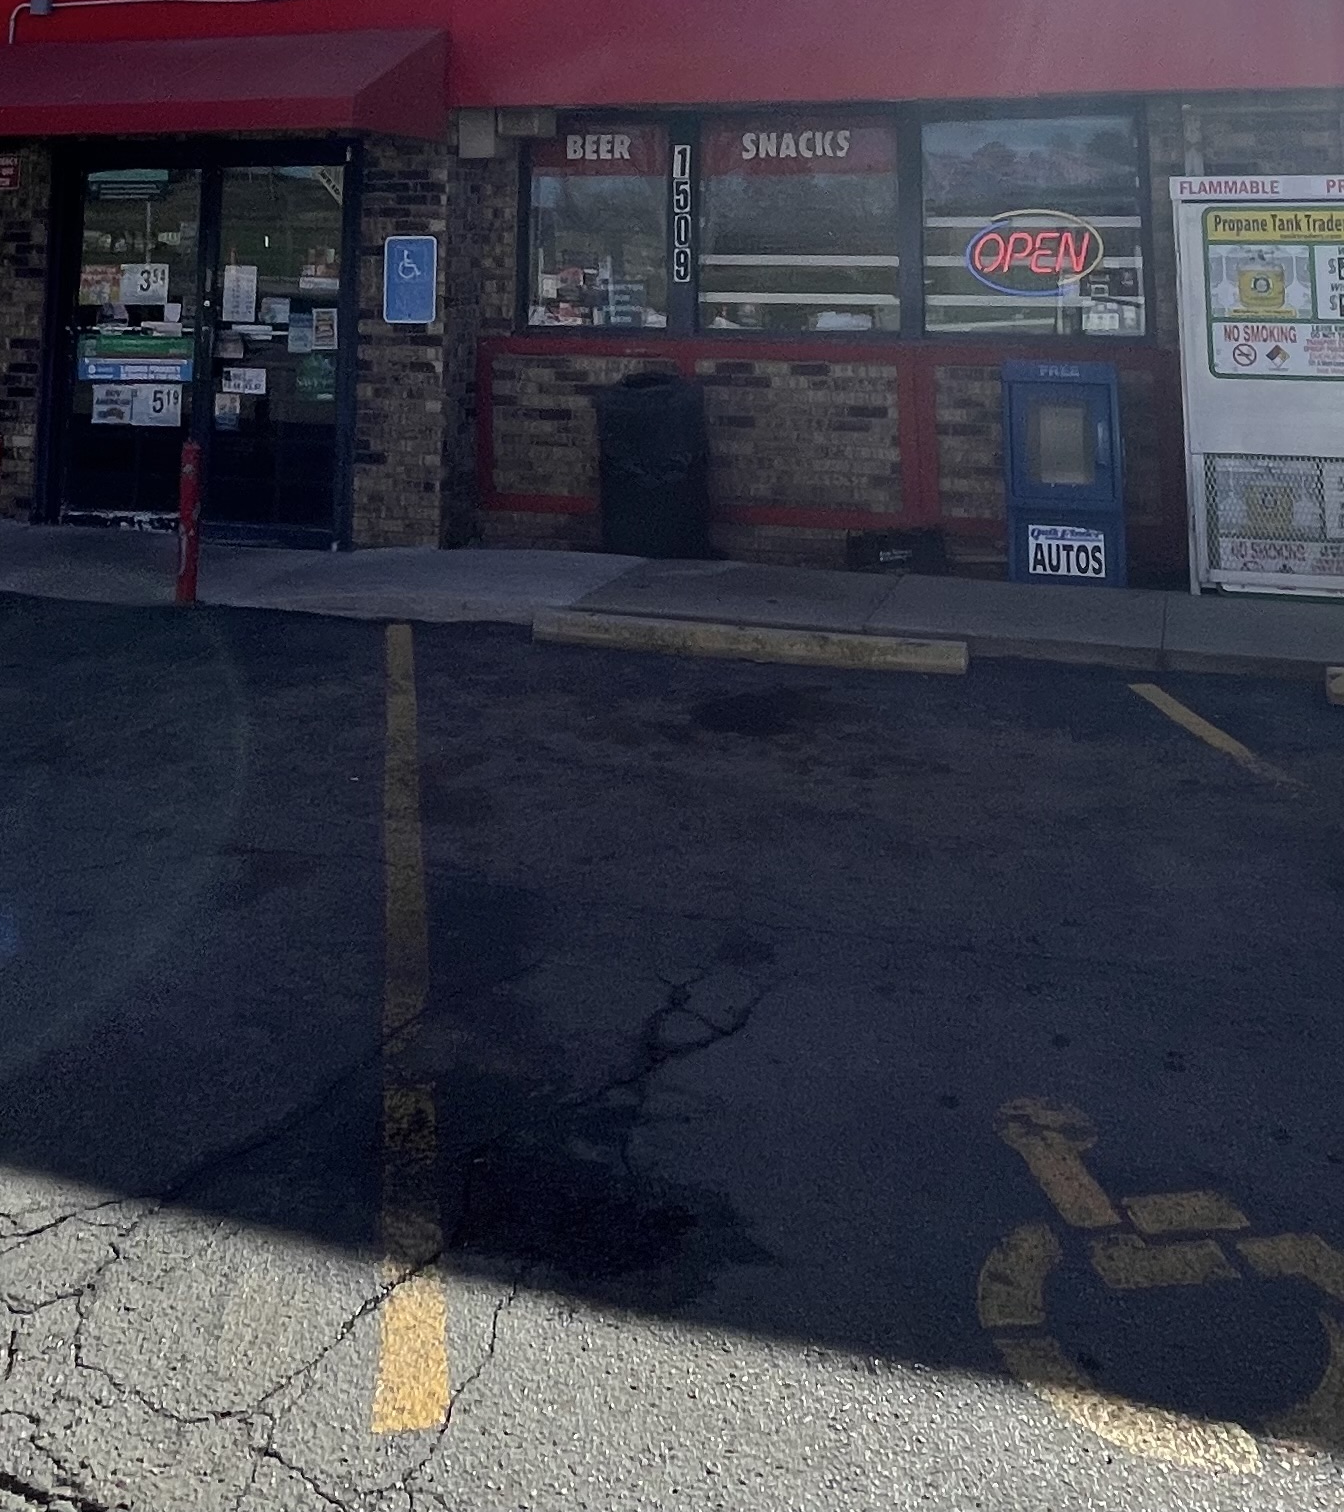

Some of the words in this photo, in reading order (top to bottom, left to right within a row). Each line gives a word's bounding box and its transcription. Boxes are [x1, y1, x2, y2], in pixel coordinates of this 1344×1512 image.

[566, 134, 631, 160] BEER
[742, 131, 851, 159] SNACKS
[1179, 179, 1280, 195] FLAMMABLE
[674, 147, 690, 281] 1509
[1214, 214, 1268, 236] Propane
[1270, 214, 1302, 232] Tank
[974, 231, 1091, 274] OPEN
[1224, 325, 1240, 342] NO
[1243, 325, 1298, 344] SMOKING
[152, 390, 179, 413] 519
[1032, 542, 1103, 580] AUTOS
